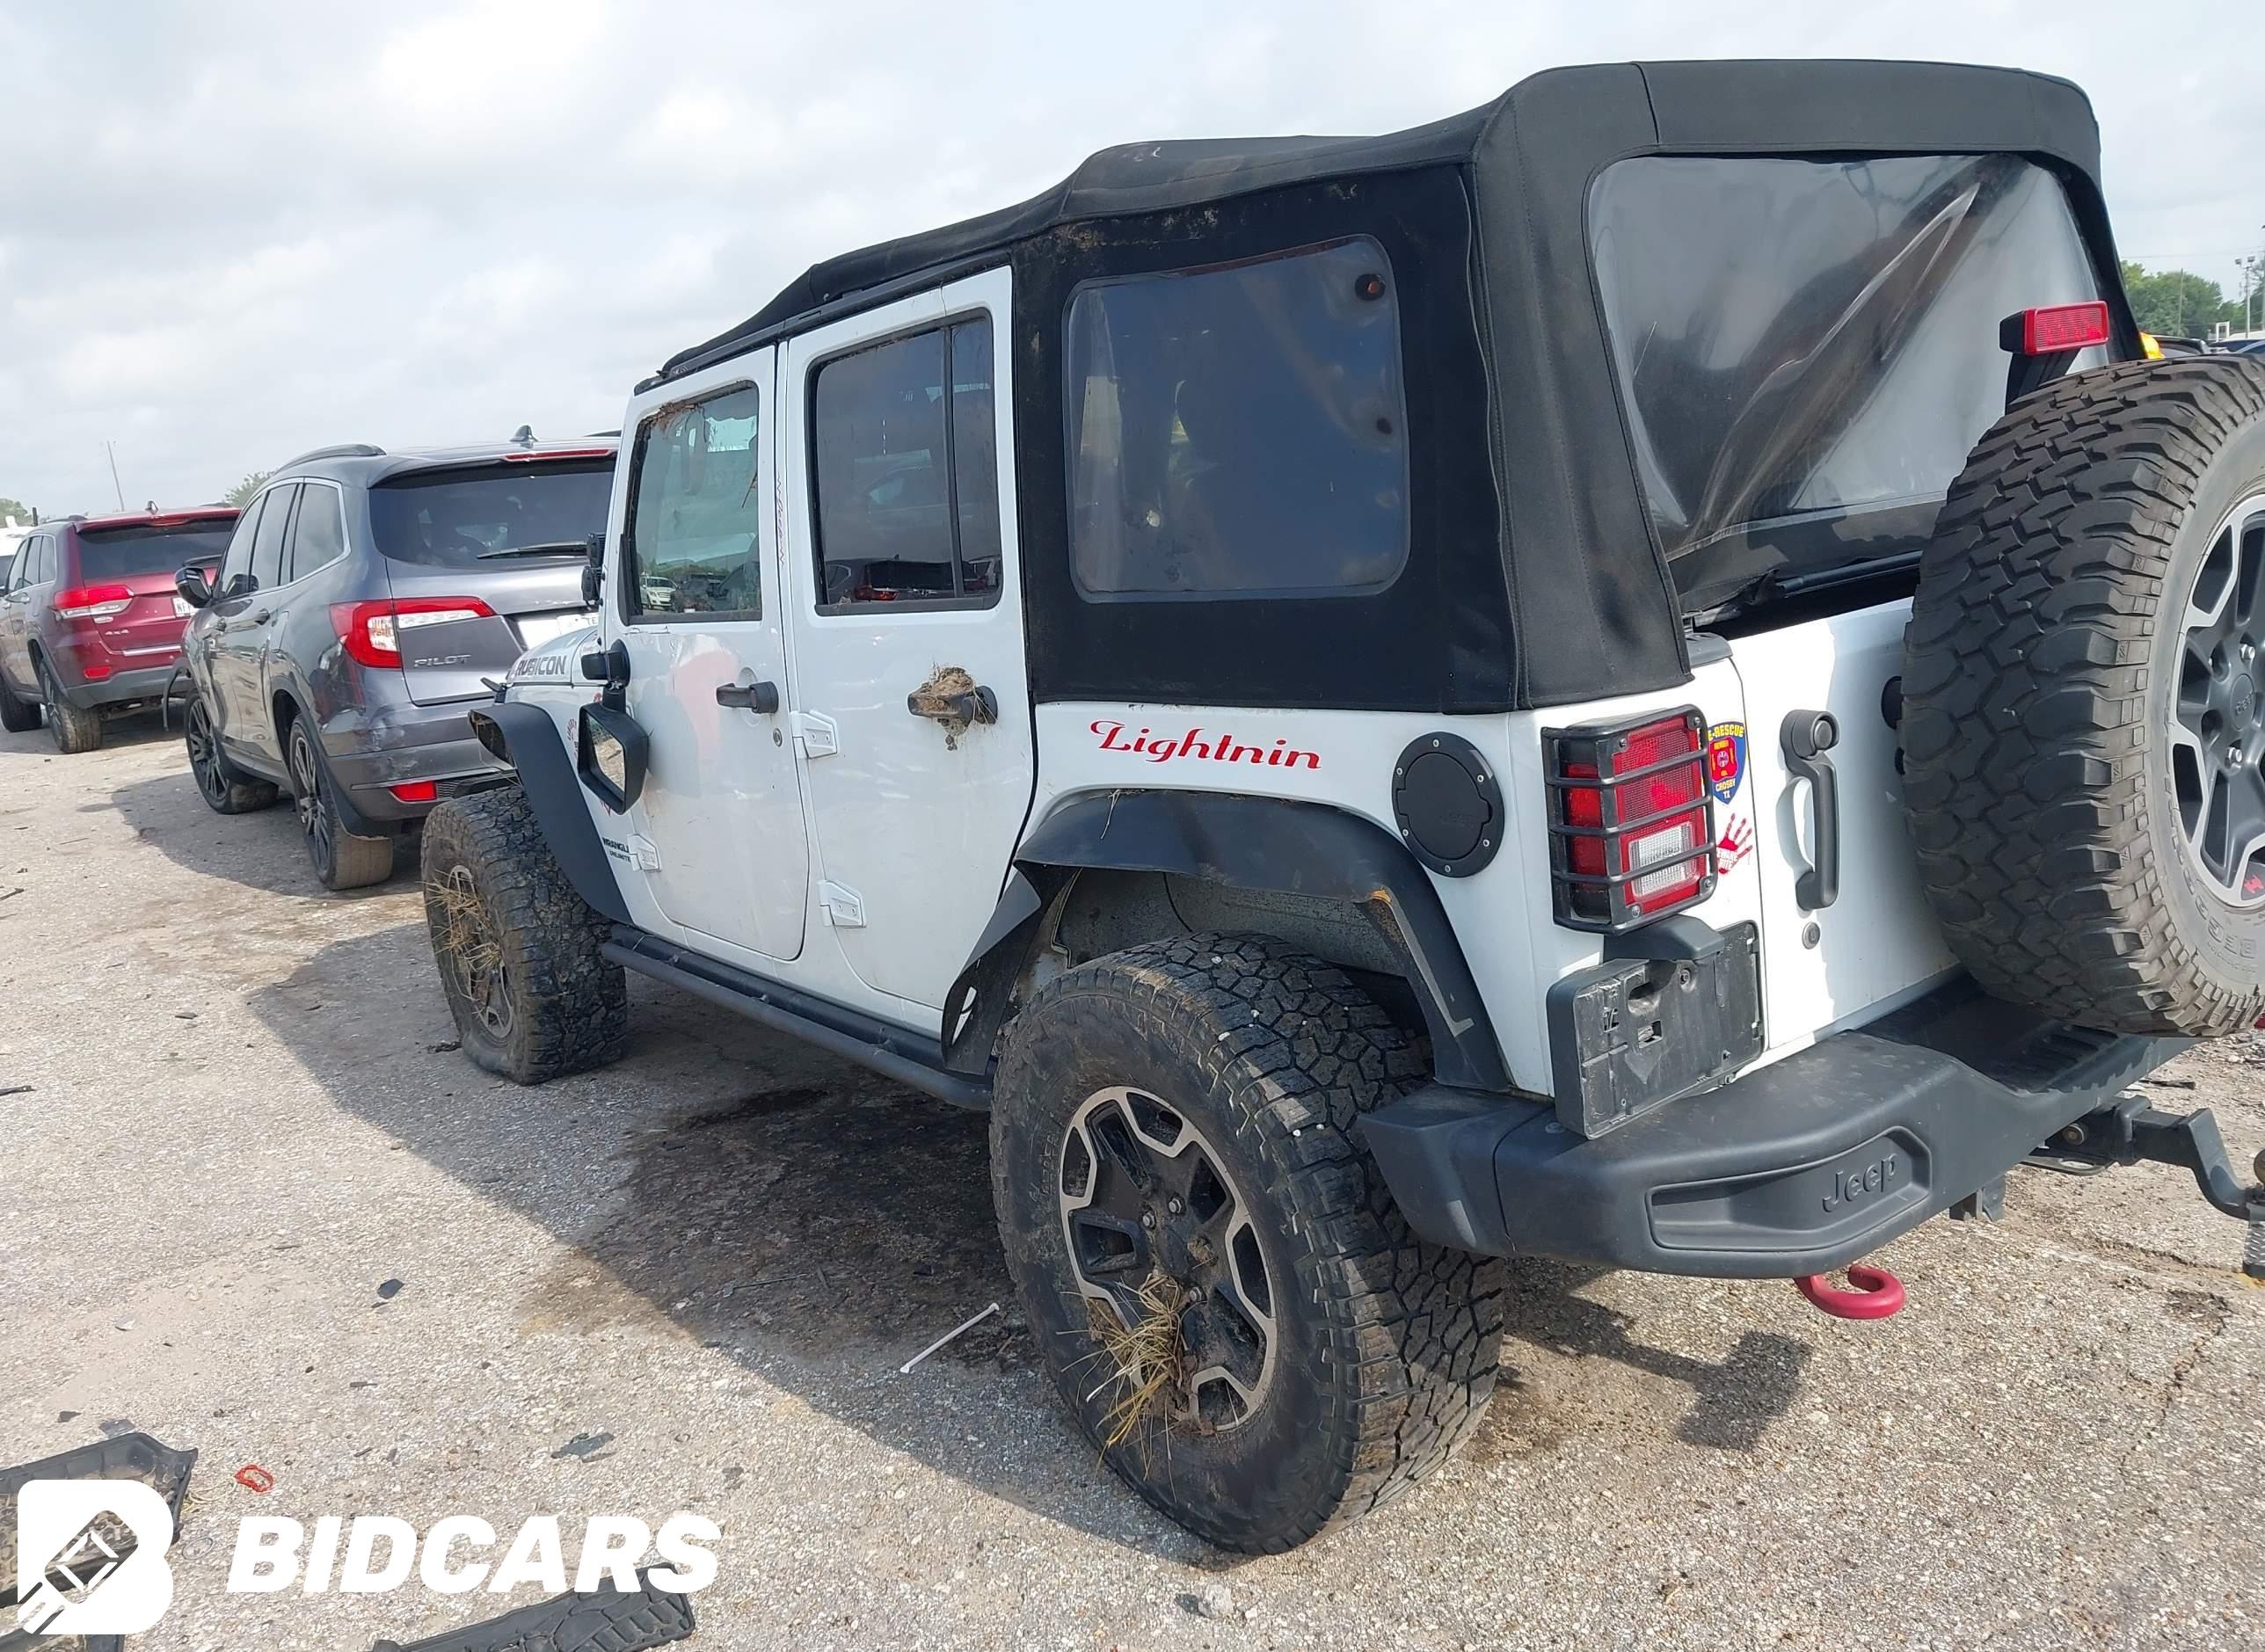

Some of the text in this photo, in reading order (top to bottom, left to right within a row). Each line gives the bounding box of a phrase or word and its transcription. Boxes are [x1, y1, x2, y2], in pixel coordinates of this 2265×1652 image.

[414, 654, 472, 668] PILOT
[515, 655, 567, 676] RUBICON
[1708, 724, 1744, 741] E-RESCUE
[1090, 720, 1322, 769] Lightnin
[1822, 1153, 1897, 1213] Jeep
